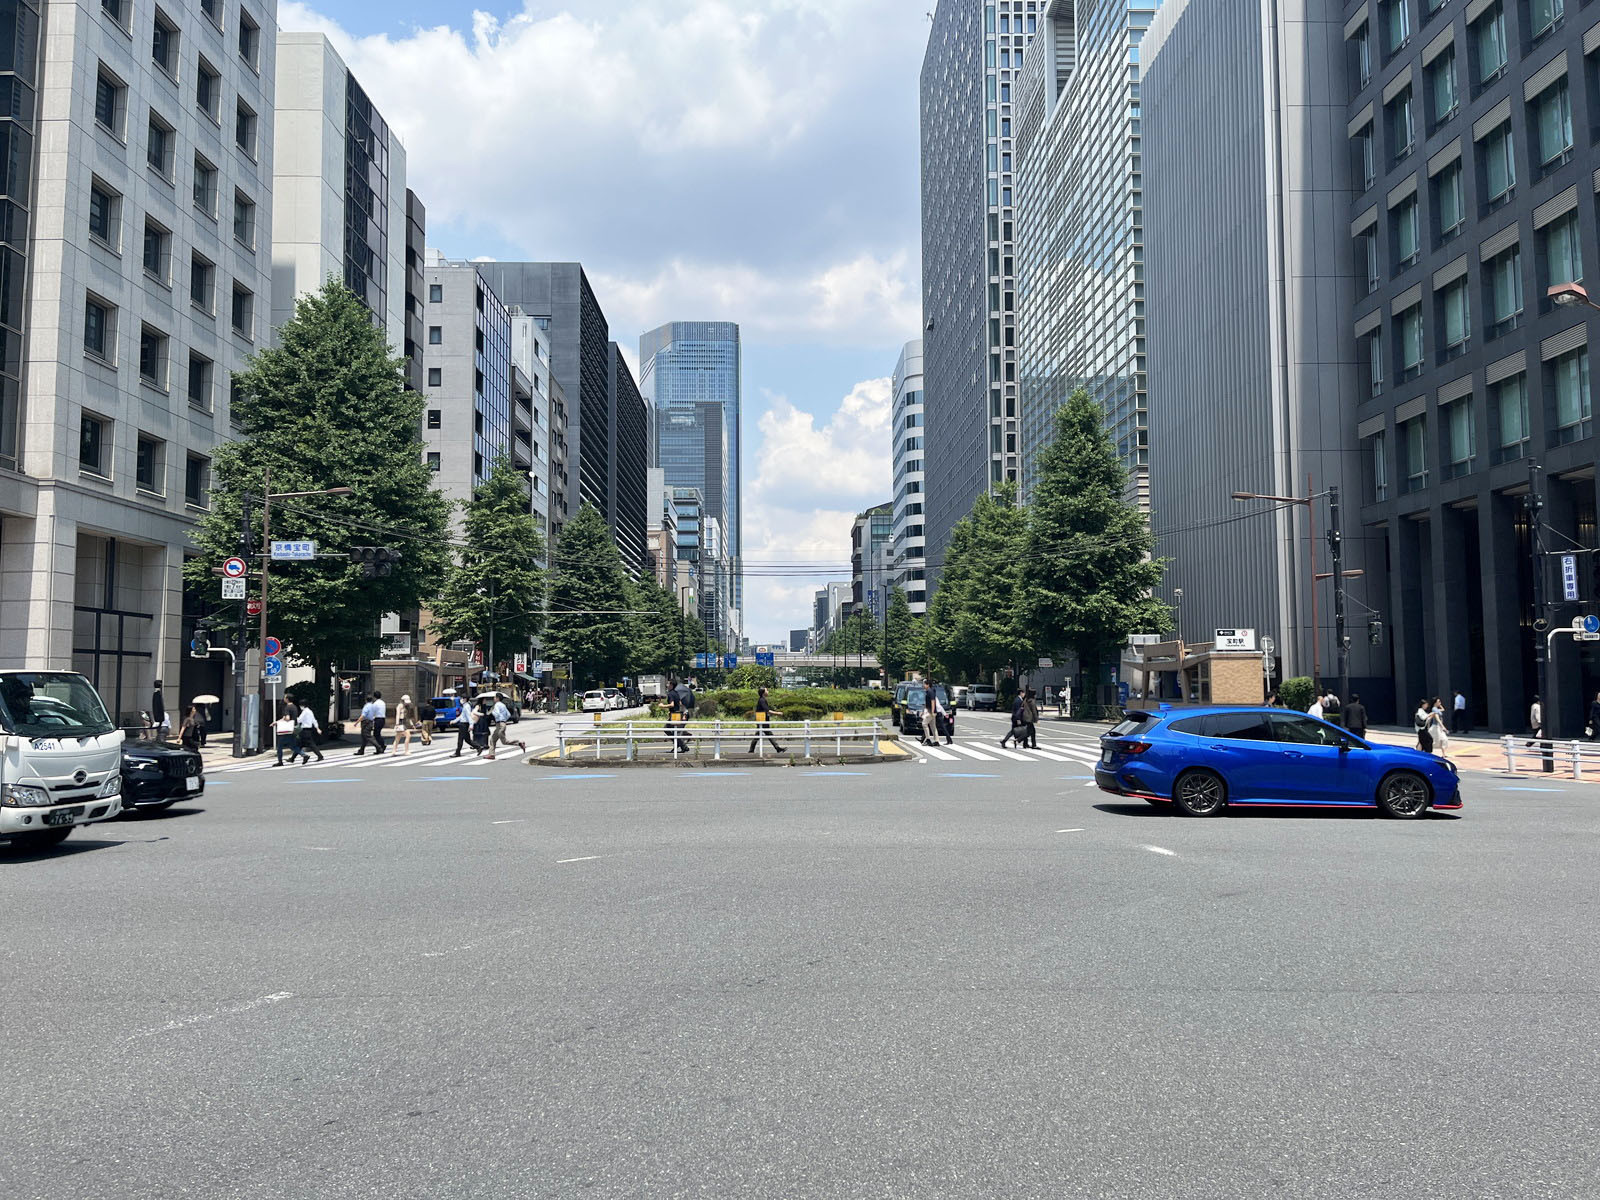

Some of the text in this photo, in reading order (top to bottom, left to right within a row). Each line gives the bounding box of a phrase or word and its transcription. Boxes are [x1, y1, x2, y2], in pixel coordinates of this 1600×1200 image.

[275, 543, 310, 552] 京橋宝町
[1564, 557, 1575, 598] 右折車専用
[265, 661, 273, 674] P
[34, 742, 55, 751] A2541
